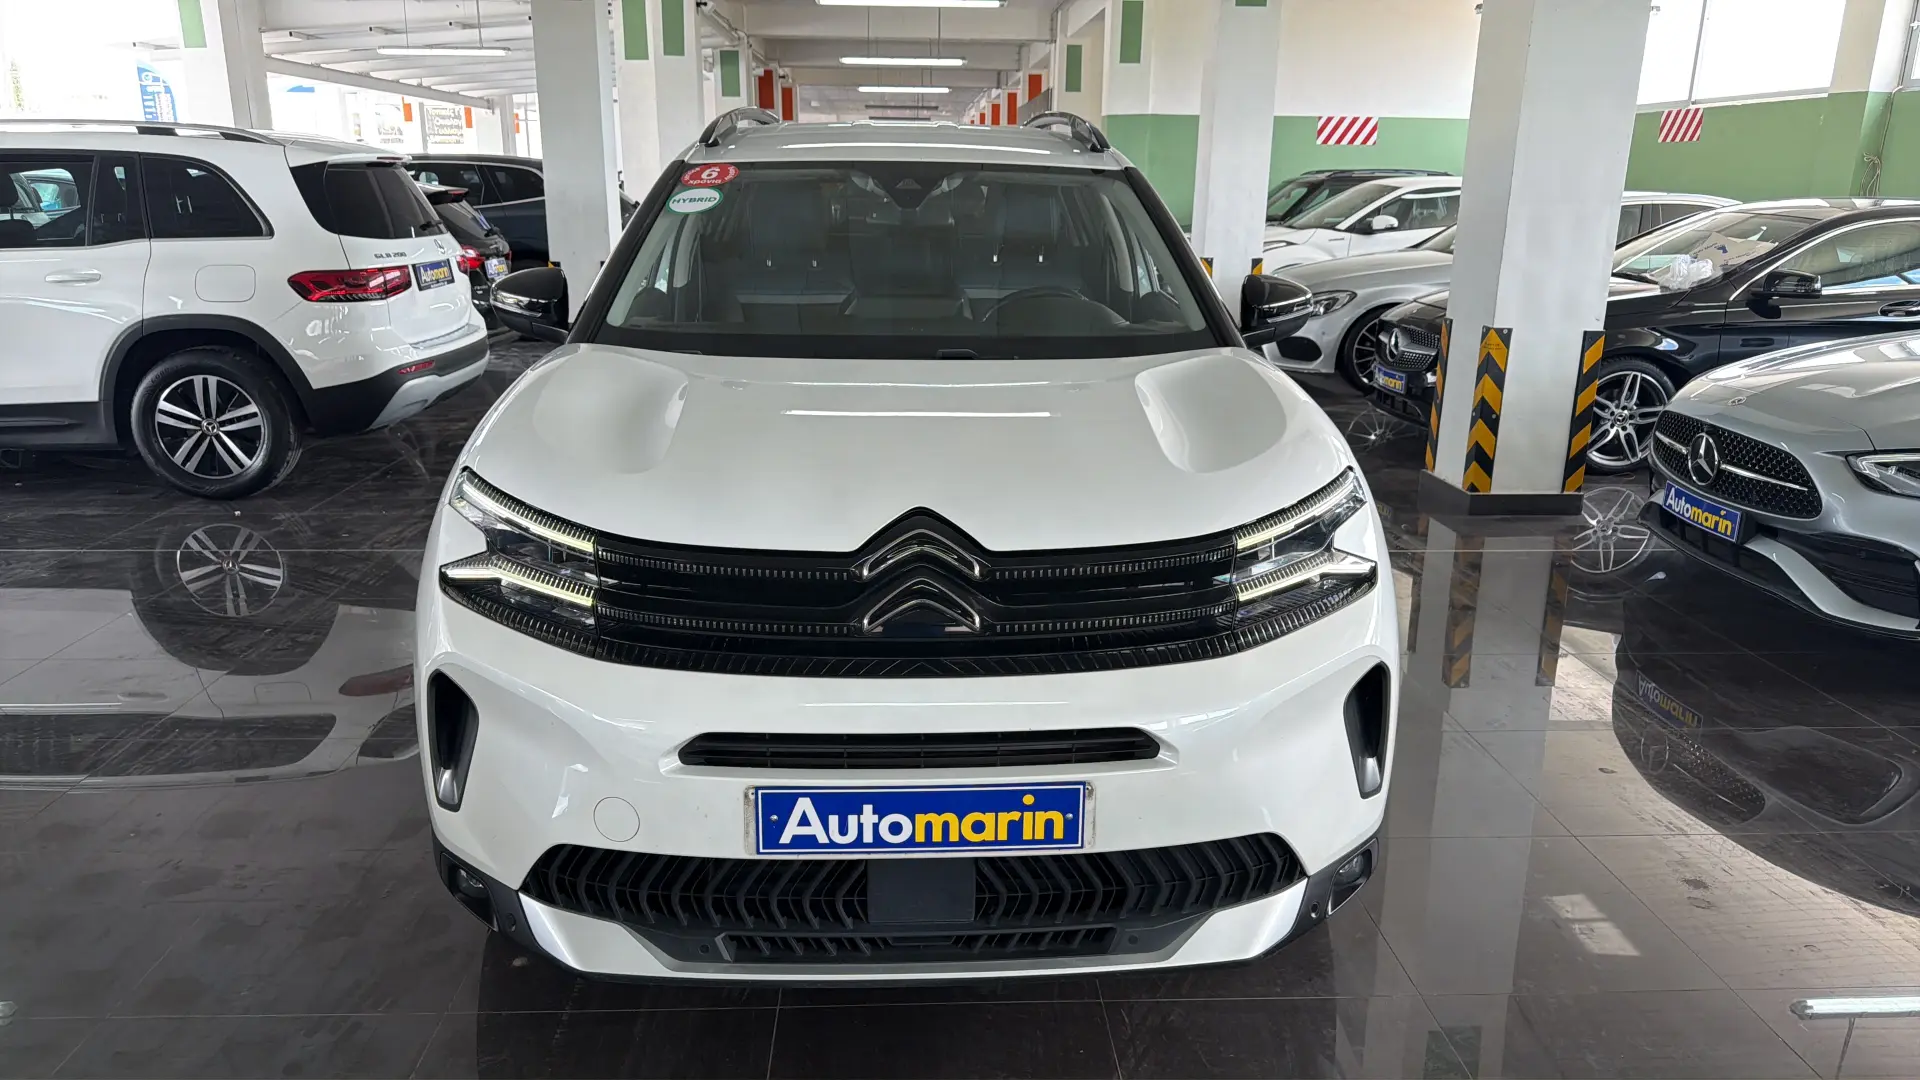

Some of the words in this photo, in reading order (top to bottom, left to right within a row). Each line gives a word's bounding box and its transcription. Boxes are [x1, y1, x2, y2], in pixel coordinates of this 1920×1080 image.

[701, 167, 720, 179] 6
[672, 196, 717, 204] HYBRID
[1665, 486, 1732, 537] Automarin
[779, 794, 1064, 844] Automarin
